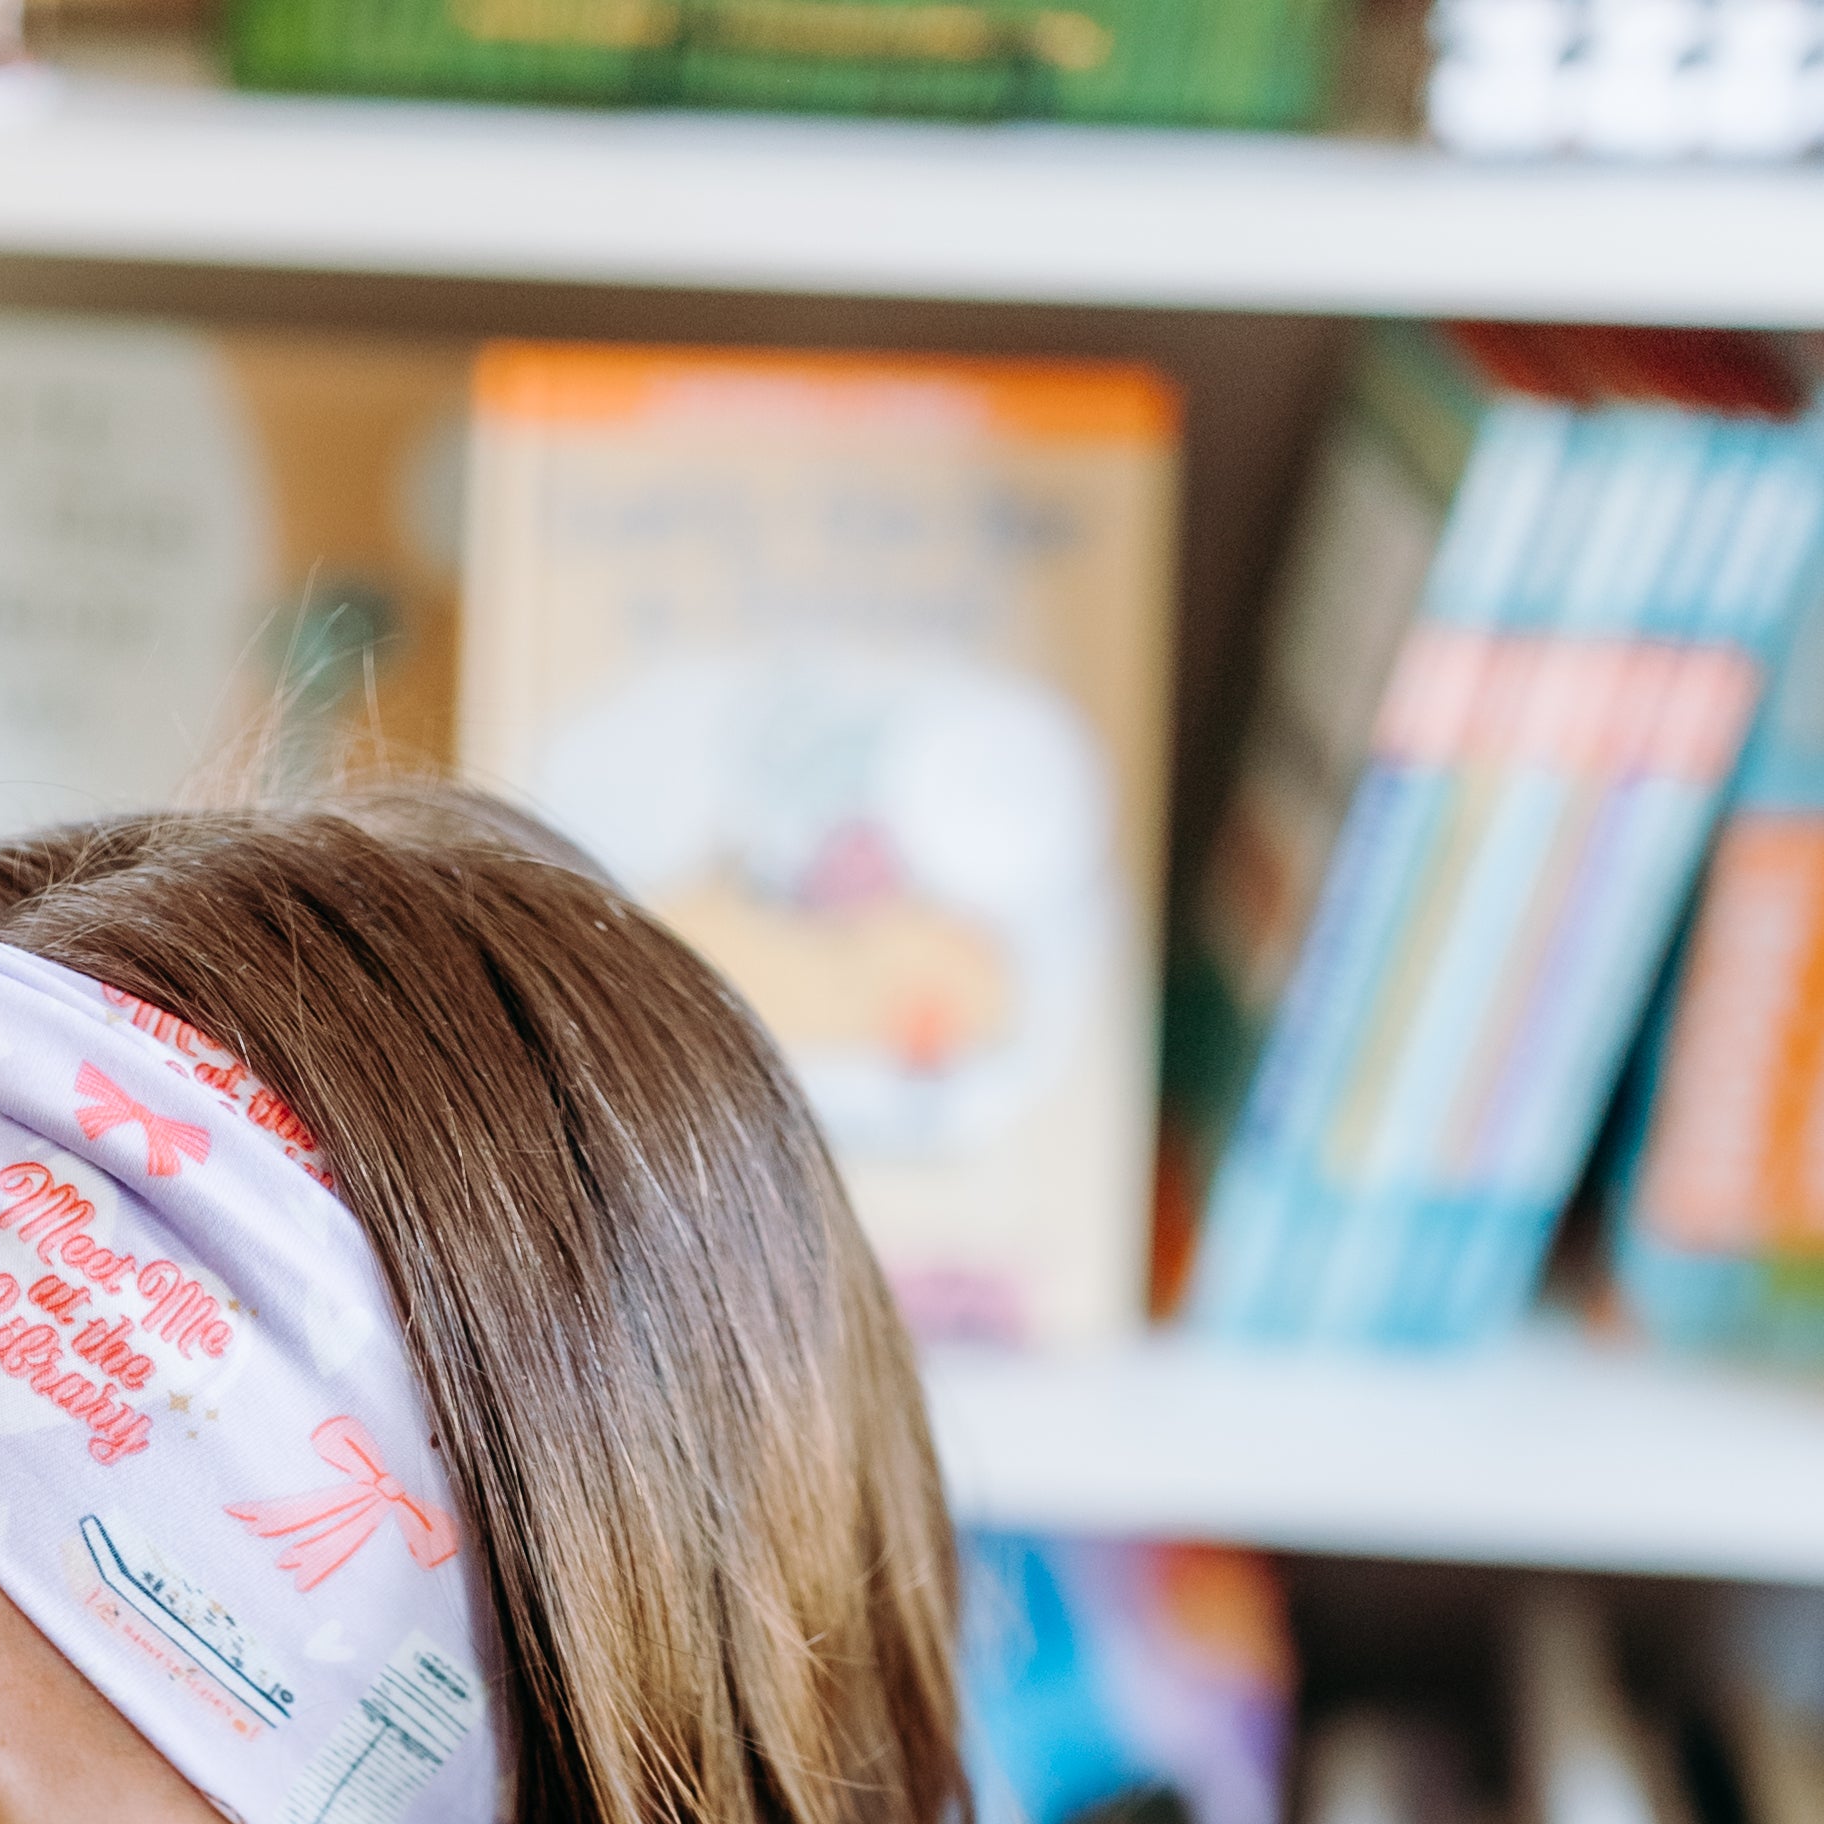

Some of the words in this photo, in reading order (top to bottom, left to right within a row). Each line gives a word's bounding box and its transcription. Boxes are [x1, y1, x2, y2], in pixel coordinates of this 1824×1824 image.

[193, 1062, 248, 1100] at
[27, 1273, 92, 1326] at
[70, 1314, 157, 1392] the
[137, 1258, 234, 1361] Me
